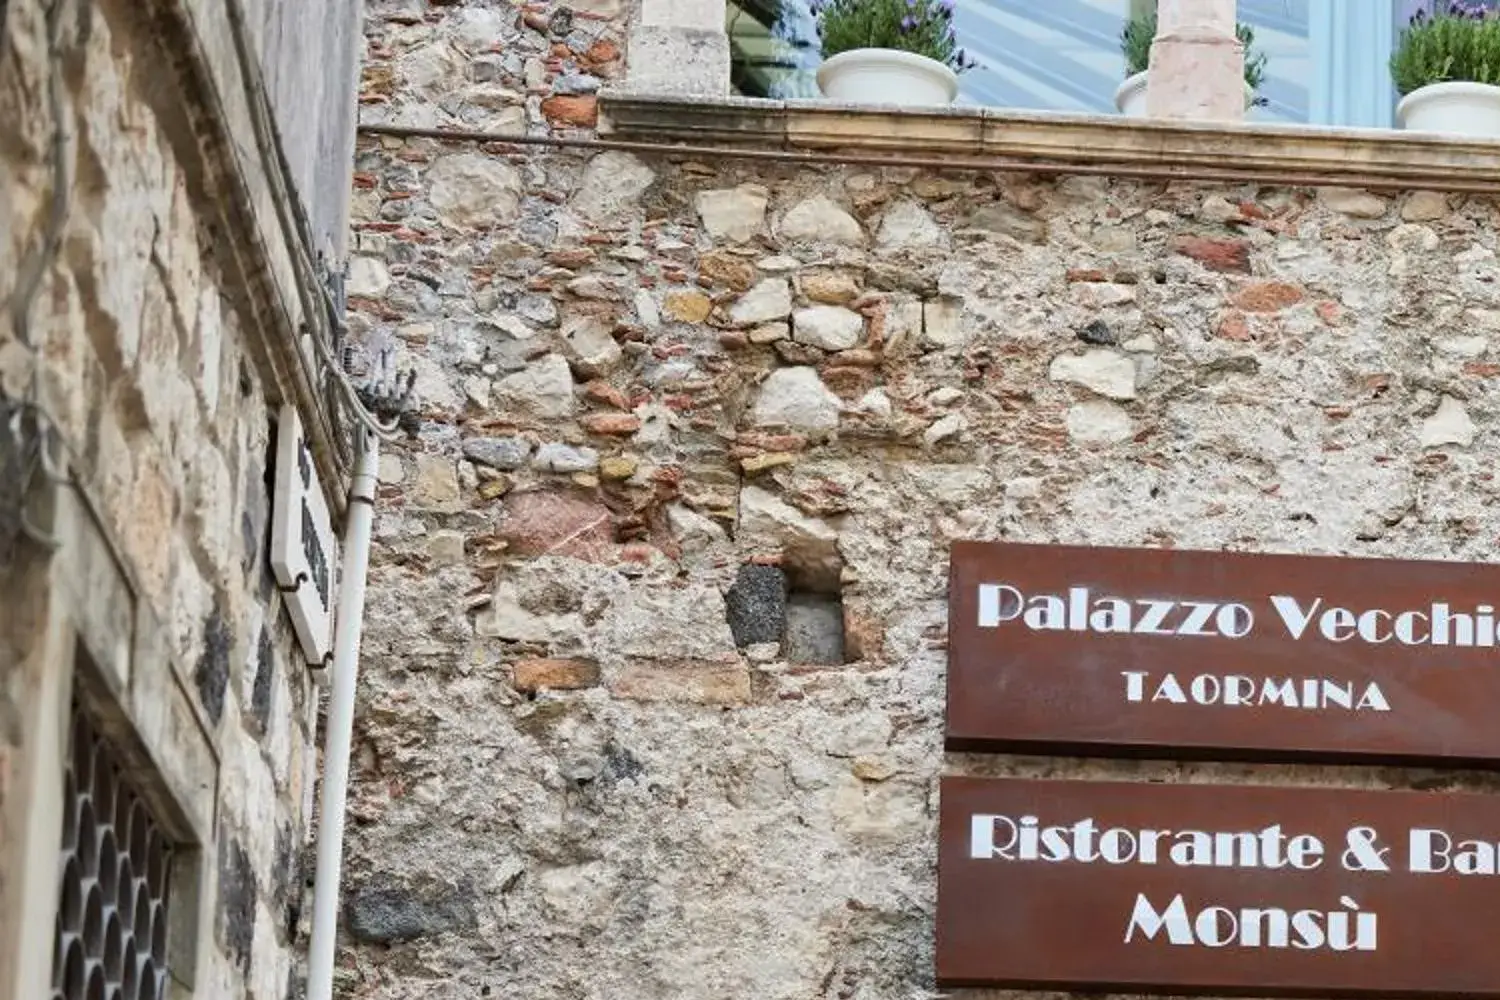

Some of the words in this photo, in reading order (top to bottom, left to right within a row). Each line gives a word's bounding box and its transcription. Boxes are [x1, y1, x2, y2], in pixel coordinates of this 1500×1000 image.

[977, 583, 1255, 639] Palazzo
[1120, 671, 1391, 711] TAORMINA
[970, 814, 1325, 870] Ristorante
[1340, 826, 1391, 872] &
[1123, 893, 1377, 951] Monsù
